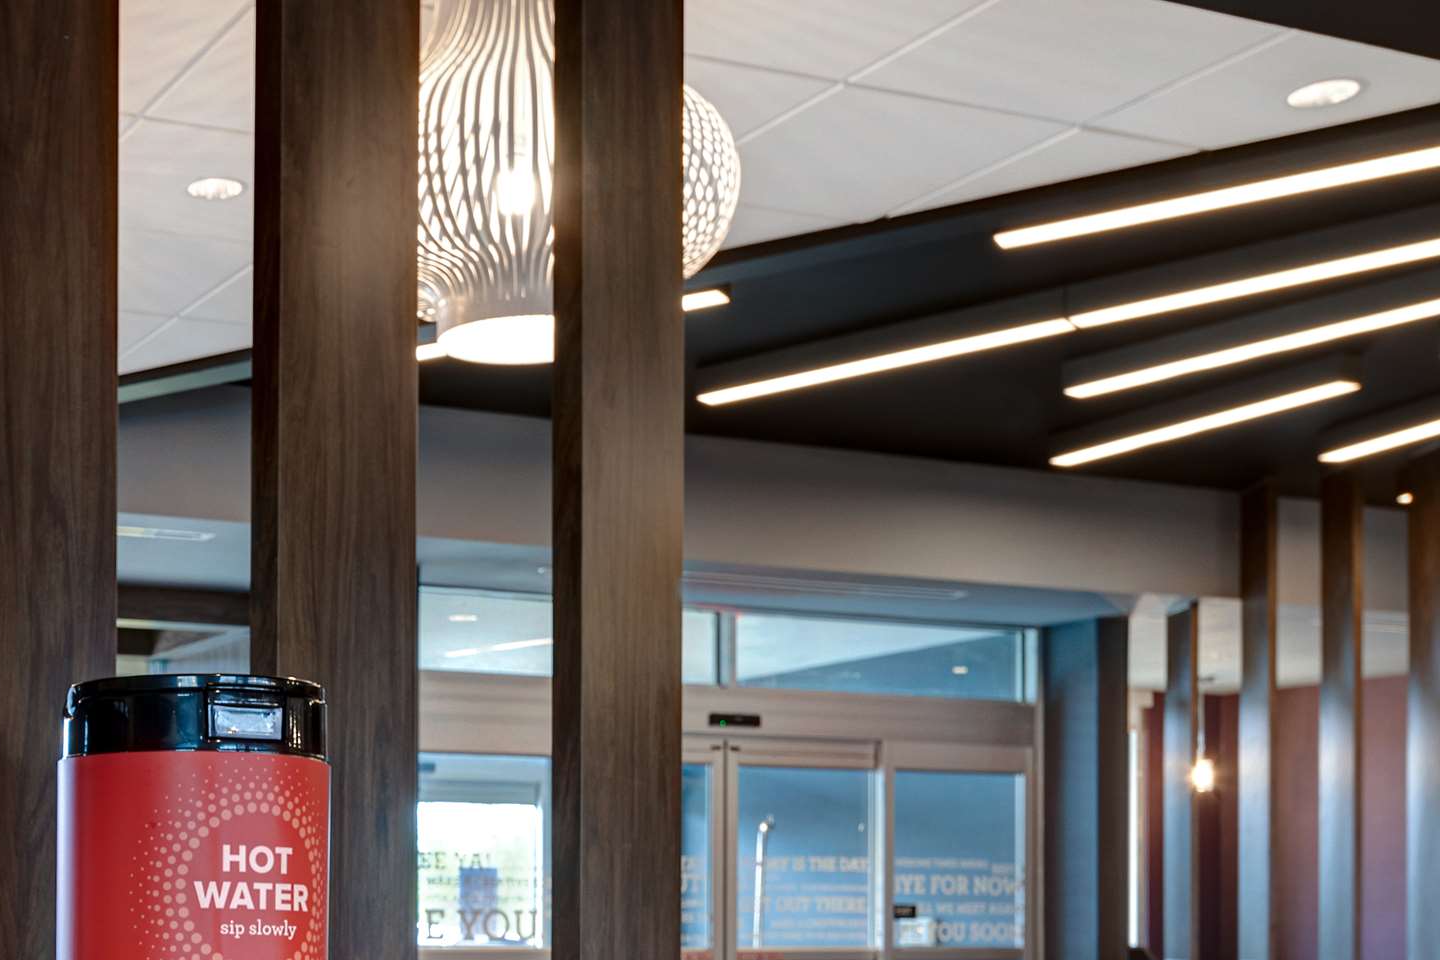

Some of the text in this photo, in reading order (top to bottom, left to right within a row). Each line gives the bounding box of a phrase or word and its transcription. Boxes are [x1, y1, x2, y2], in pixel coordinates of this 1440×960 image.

[221, 844, 293, 875] HOT
[193, 880, 309, 913] WATER
[930, 873, 969, 896] FOR
[220, 919, 297, 941] sip slowly
[457, 908, 538, 941] YOU
